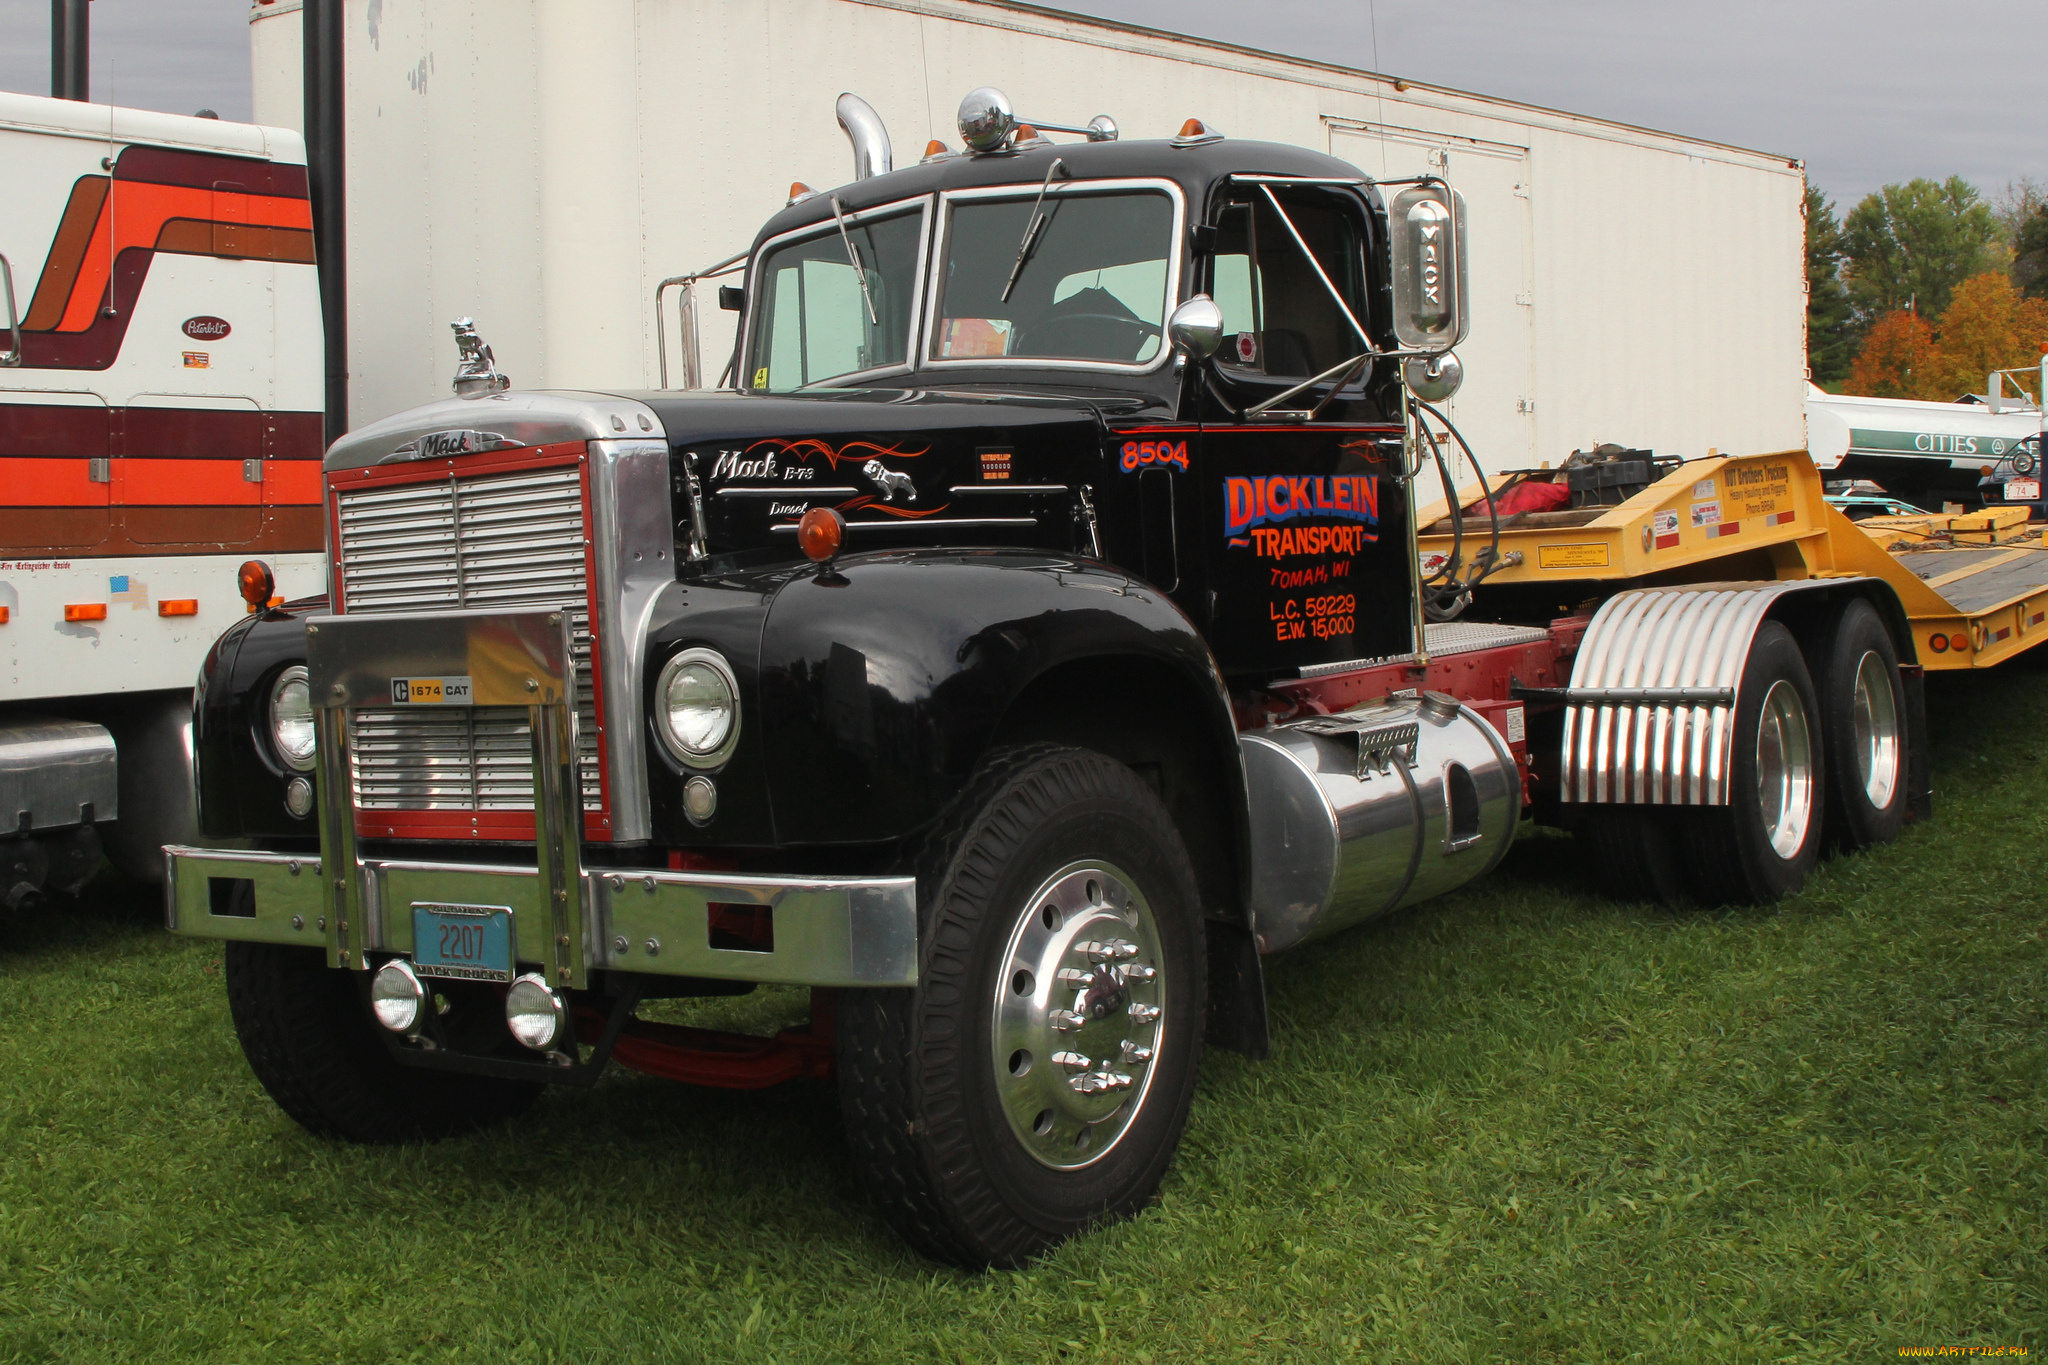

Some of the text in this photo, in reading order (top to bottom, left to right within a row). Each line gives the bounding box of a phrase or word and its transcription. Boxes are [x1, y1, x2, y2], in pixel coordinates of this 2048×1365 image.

[1420, 225, 1440, 305] MACK
[187, 320, 227, 334] Peterbilt
[421, 431, 470, 456] Mack
[1119, 440, 1190, 473] 8504
[1915, 433, 1977, 454] CITIES
[709, 449, 779, 480] Mack
[769, 501, 808, 516] Diesel
[1223, 475, 1379, 537] DICKLEIN
[1251, 525, 1363, 560] TRANSPORT
[1270, 560, 1350, 589] TOMAH, WI
[1270, 594, 1356, 620] L.C. 59229
[1276, 616, 1355, 641] E.W. 15,000
[411, 686, 441, 696] 1674
[445, 685, 469, 696] CAT
[439, 923, 484, 960] 2207
[416, 965, 508, 981] MACK TRUCKS
